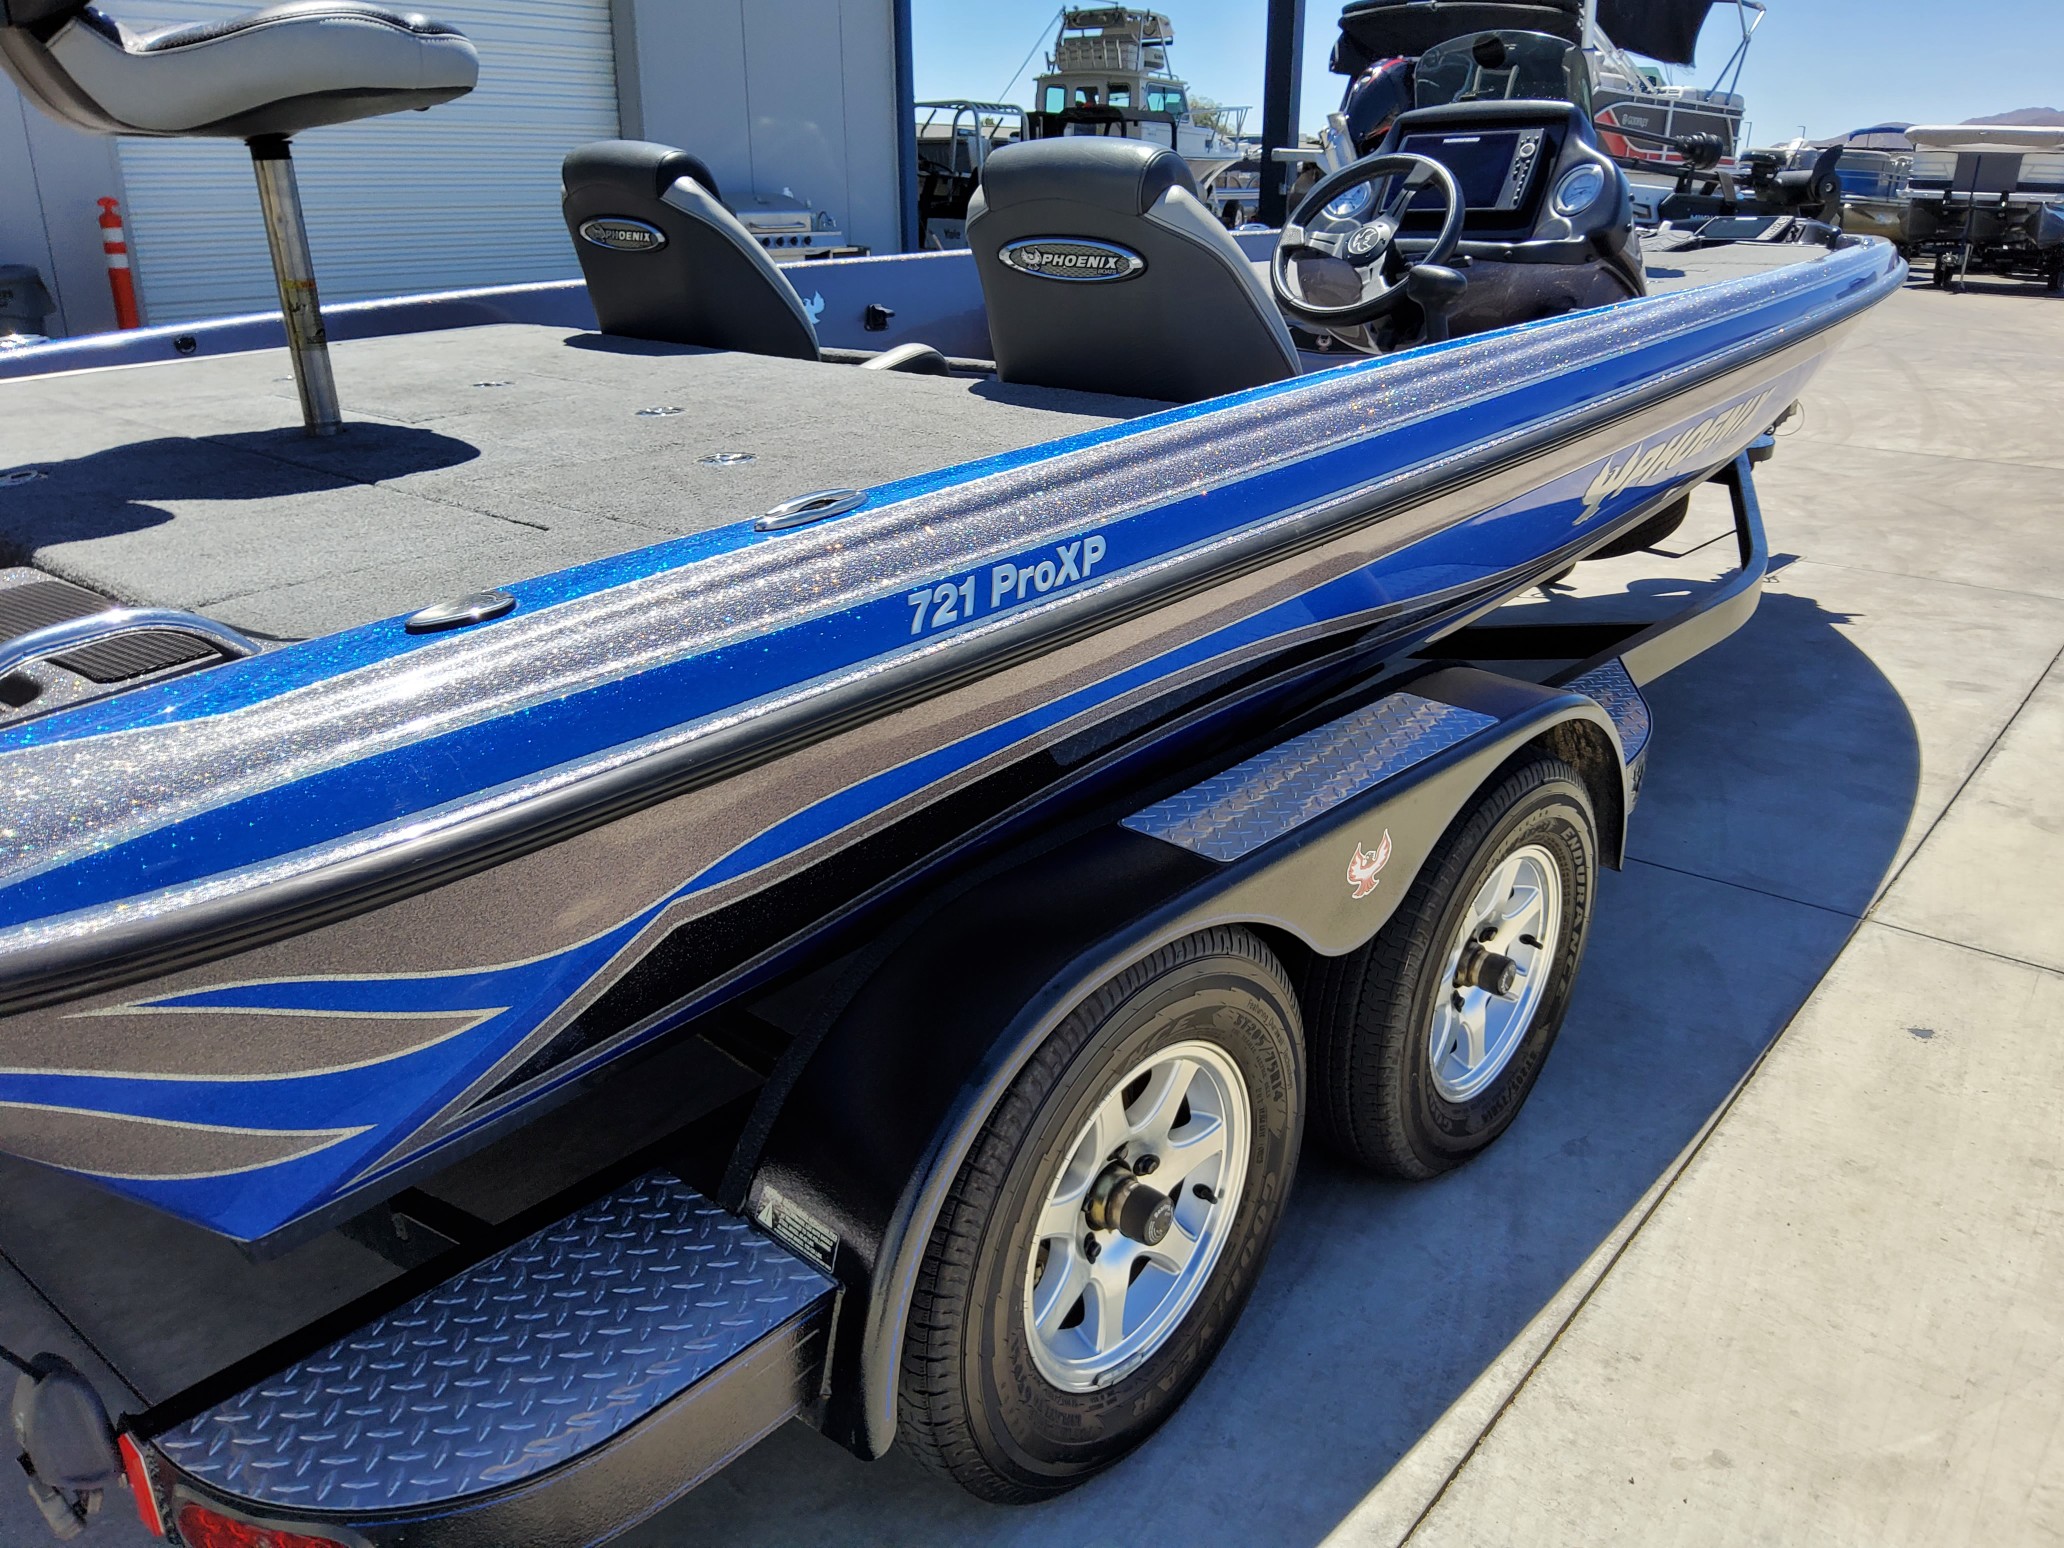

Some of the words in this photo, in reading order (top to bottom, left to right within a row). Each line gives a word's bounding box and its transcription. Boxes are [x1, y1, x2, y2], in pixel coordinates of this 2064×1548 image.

[605, 229, 651, 242] PHOENIX
[1041, 254, 1119, 269] PHOENIX
[908, 576, 976, 636] 721
[990, 535, 1107, 609] ProXP
[1558, 826, 1586, 998] ENDURANCE
